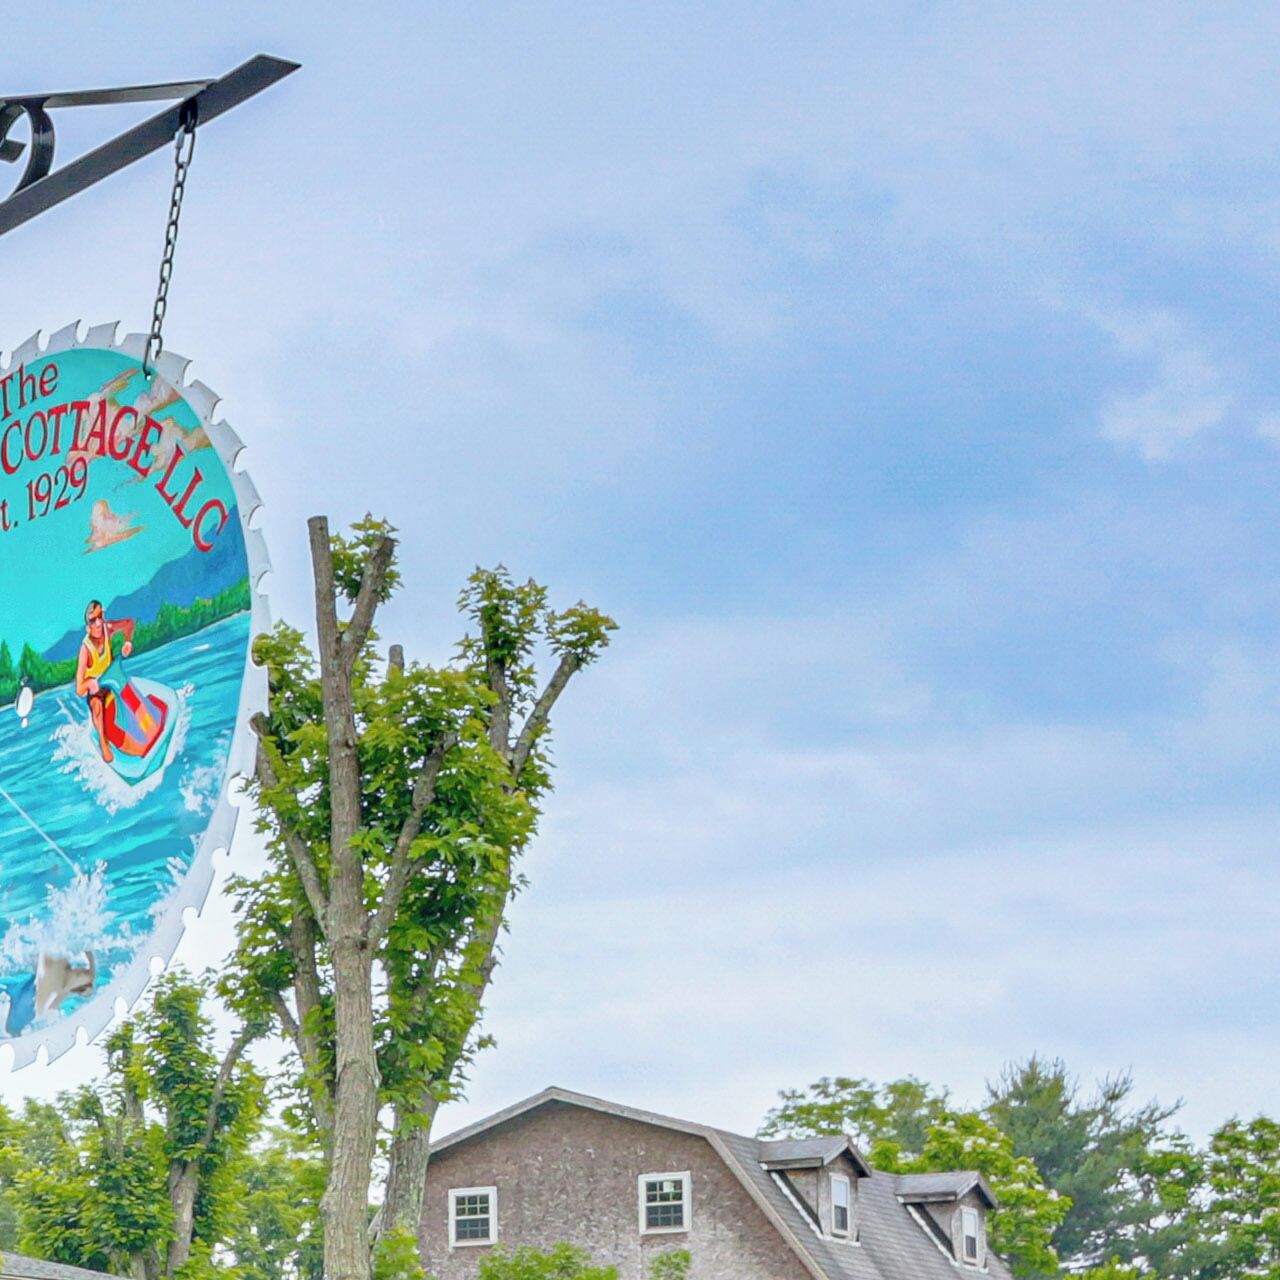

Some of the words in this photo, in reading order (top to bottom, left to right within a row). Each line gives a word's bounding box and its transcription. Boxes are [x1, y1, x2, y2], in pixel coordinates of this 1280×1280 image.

[1, 398, 163, 476] COTTAGE
[155, 445, 229, 553] LLC
[26, 457, 89, 521] 1929
